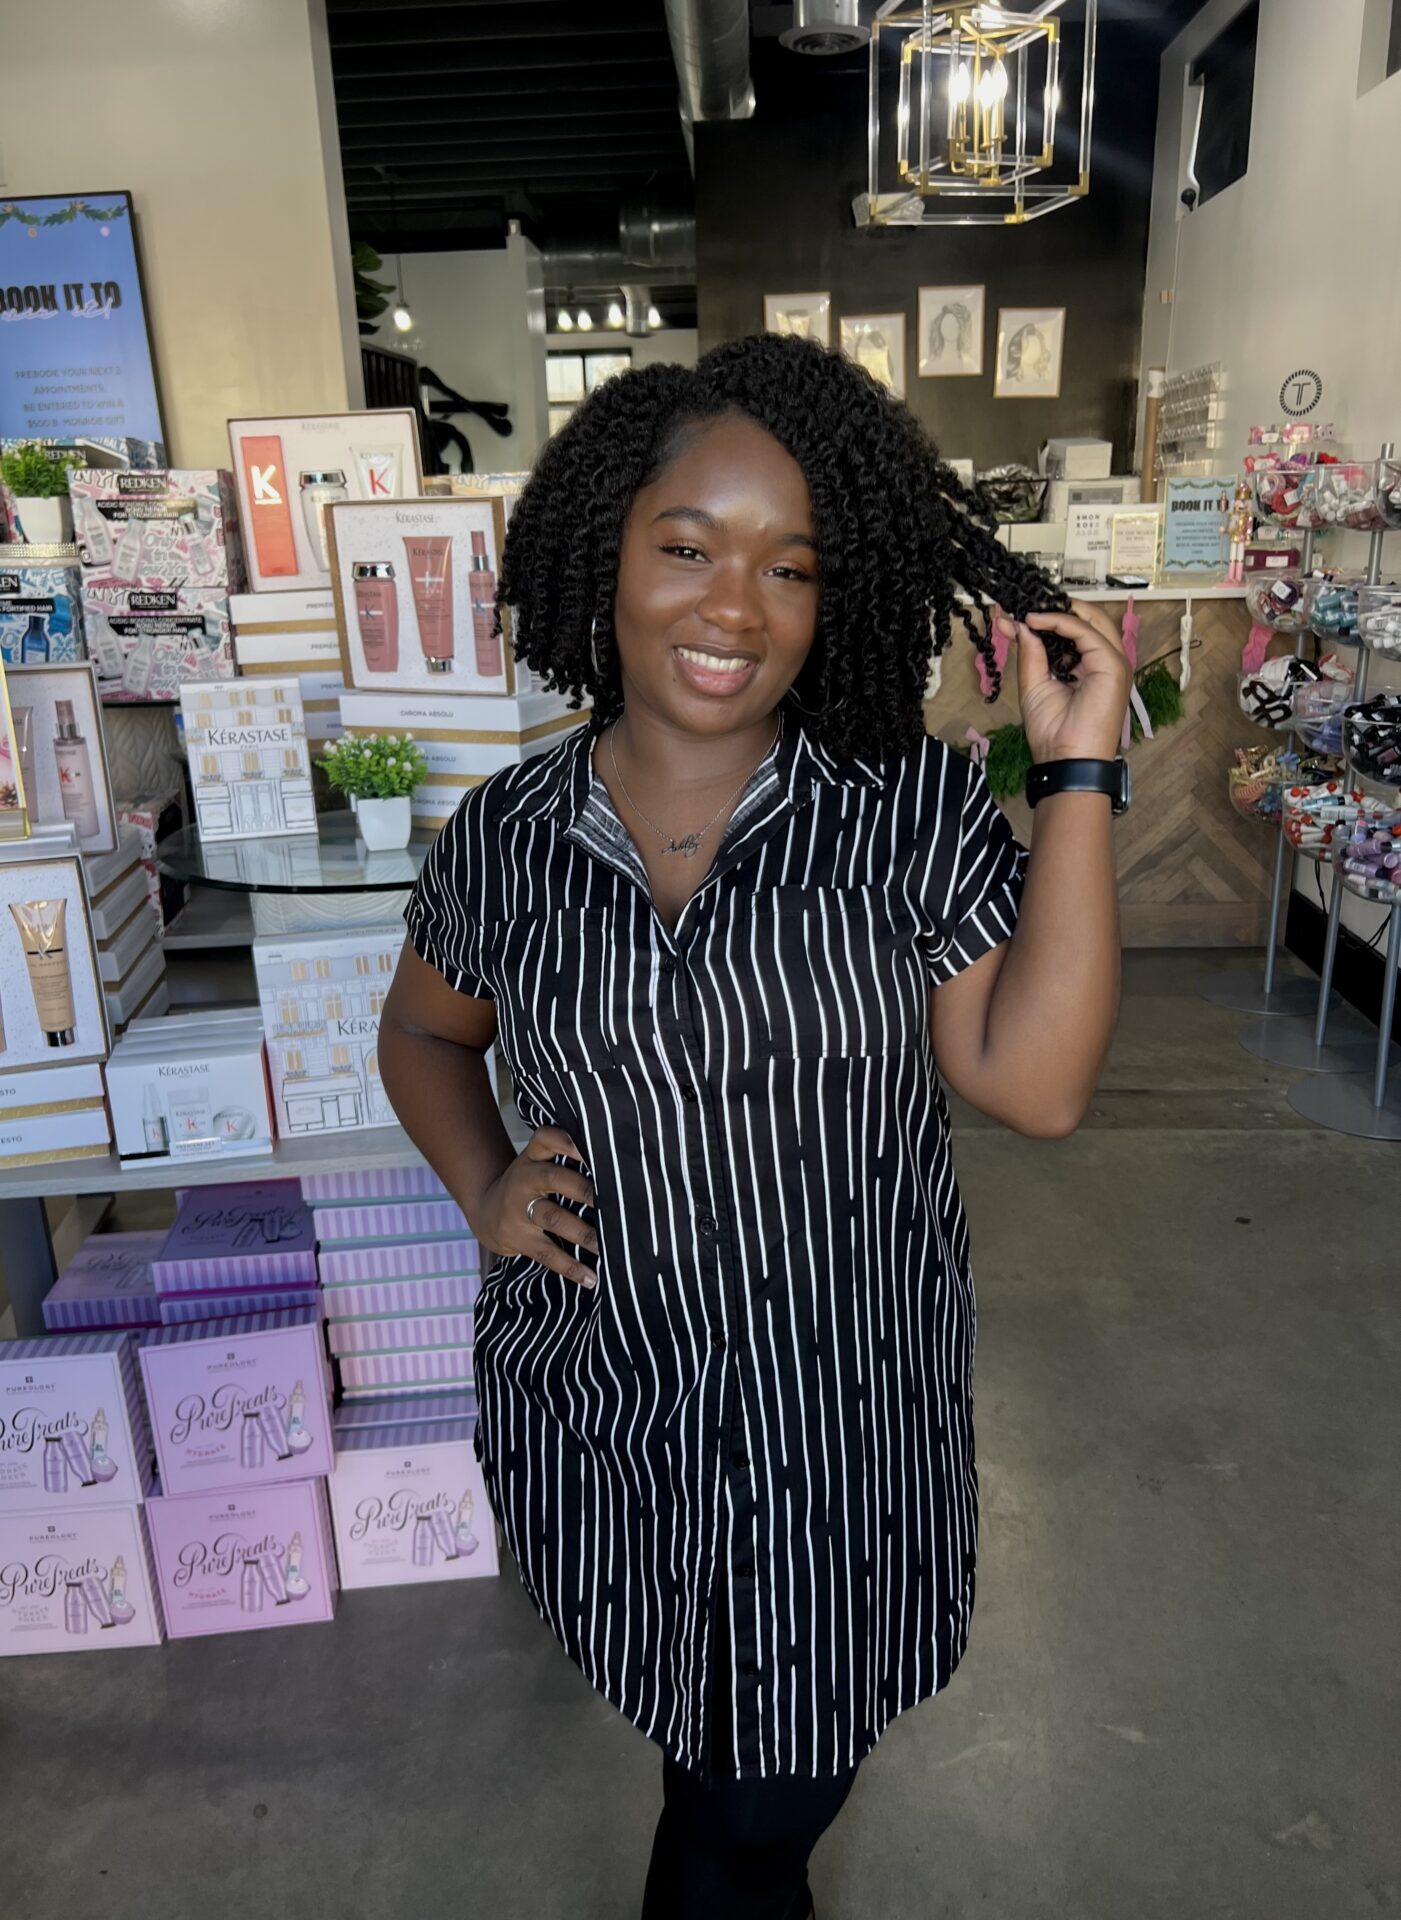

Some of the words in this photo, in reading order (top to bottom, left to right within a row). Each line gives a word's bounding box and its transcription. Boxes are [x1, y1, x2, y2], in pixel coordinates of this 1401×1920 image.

[62, 282, 84, 311] IT
[90, 280, 122, 309] TO
[119, 477, 168, 490] REDKEN
[369, 468, 391, 496] K
[1171, 499, 1201, 513] BOOK
[1204, 500, 1214, 512] IT
[130, 594, 177, 606] REDKEN
[2, 604, 36, 613] FORTIFIED
[36, 604, 53, 612] HAIR
[157, 616, 202, 624] CONCENTRATE
[400, 709, 427, 718] CHROMA
[428, 711, 455, 719] ABSOLU
[208, 728, 289, 746] KÉRASTASE
[431, 755, 457, 763] ABSOLU
[0, 1135, 23, 1145] ESTO
[5, 1383, 56, 1393] PUREOLOGY
[28, 1532, 78, 1542] PUREOLOGY
